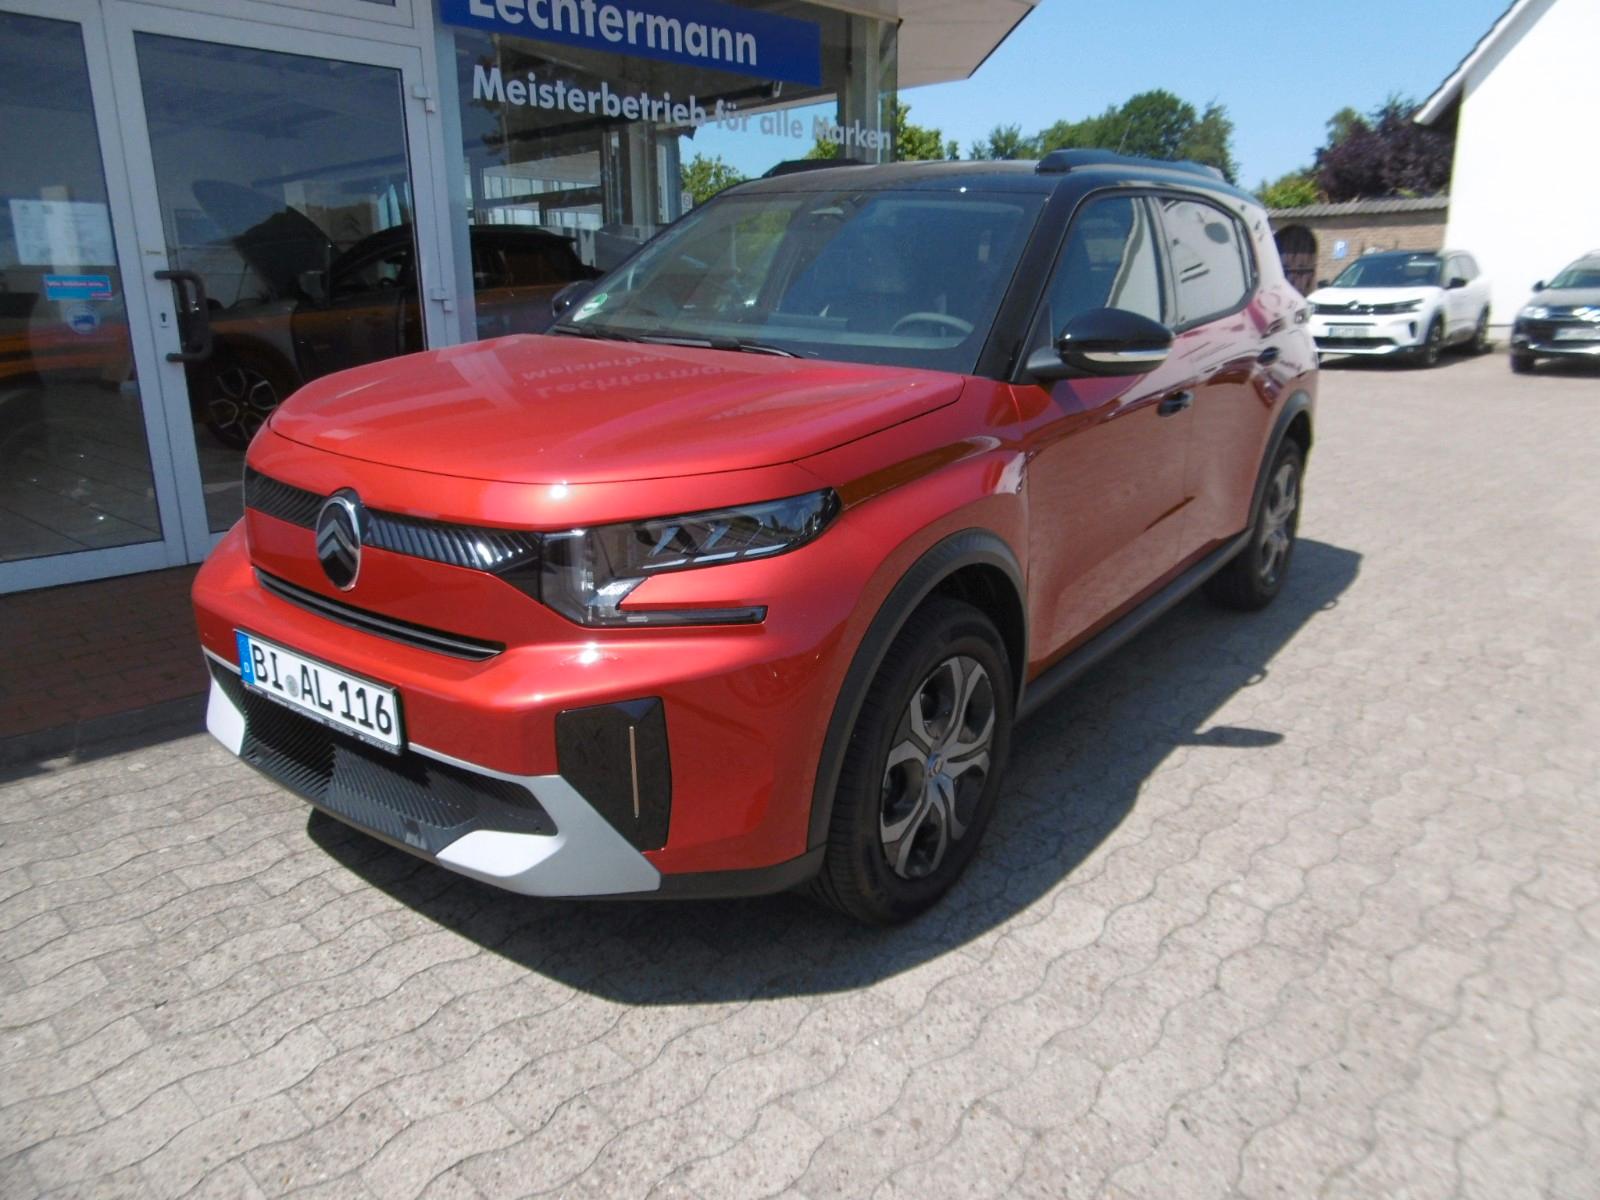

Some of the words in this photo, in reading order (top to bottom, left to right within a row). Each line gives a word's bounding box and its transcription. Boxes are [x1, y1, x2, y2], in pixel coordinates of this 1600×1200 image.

[472, 64, 706, 128] Meisterbetrieb
[714, 98, 752, 133] für
[759, 109, 804, 139] alle
[811, 114, 892, 151] Marken
[251, 643, 284, 692] BI
[300, 664, 334, 713] AL
[338, 680, 393, 736] 116
